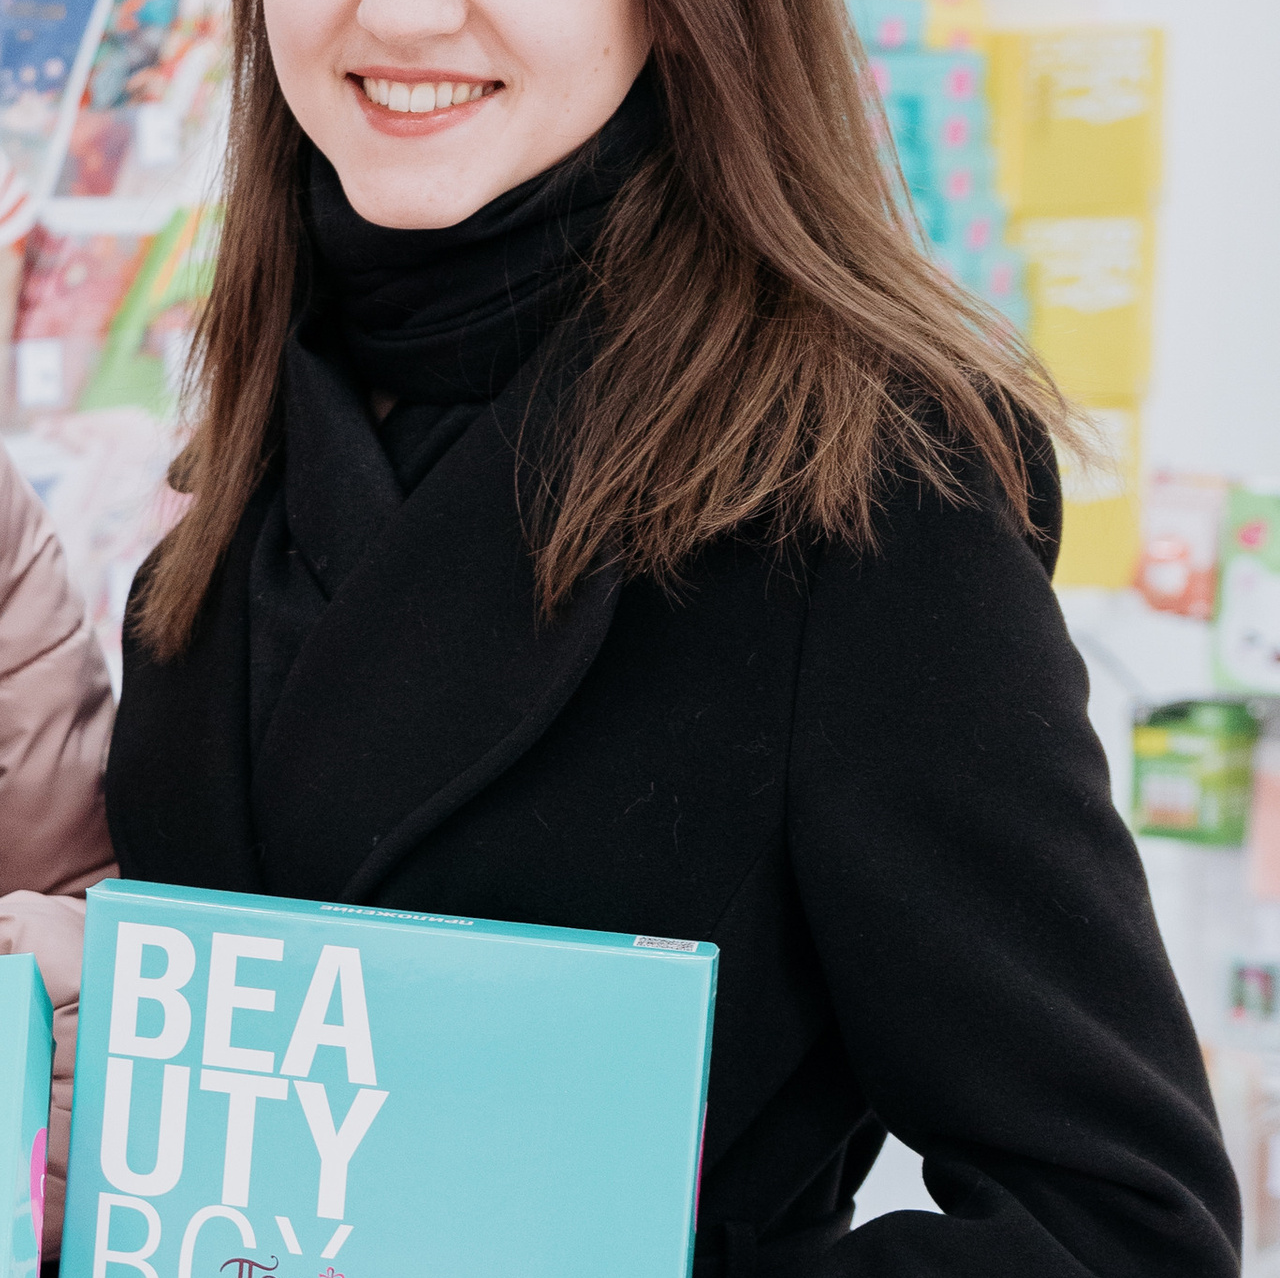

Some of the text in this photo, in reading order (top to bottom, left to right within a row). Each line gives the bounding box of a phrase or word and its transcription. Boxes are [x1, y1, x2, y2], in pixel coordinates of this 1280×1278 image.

[320, 904, 474, 926] ПРИЛОЖЕНИЕ
[108, 920, 378, 1086] BEA
[99, 1056, 390, 1221] UTY
